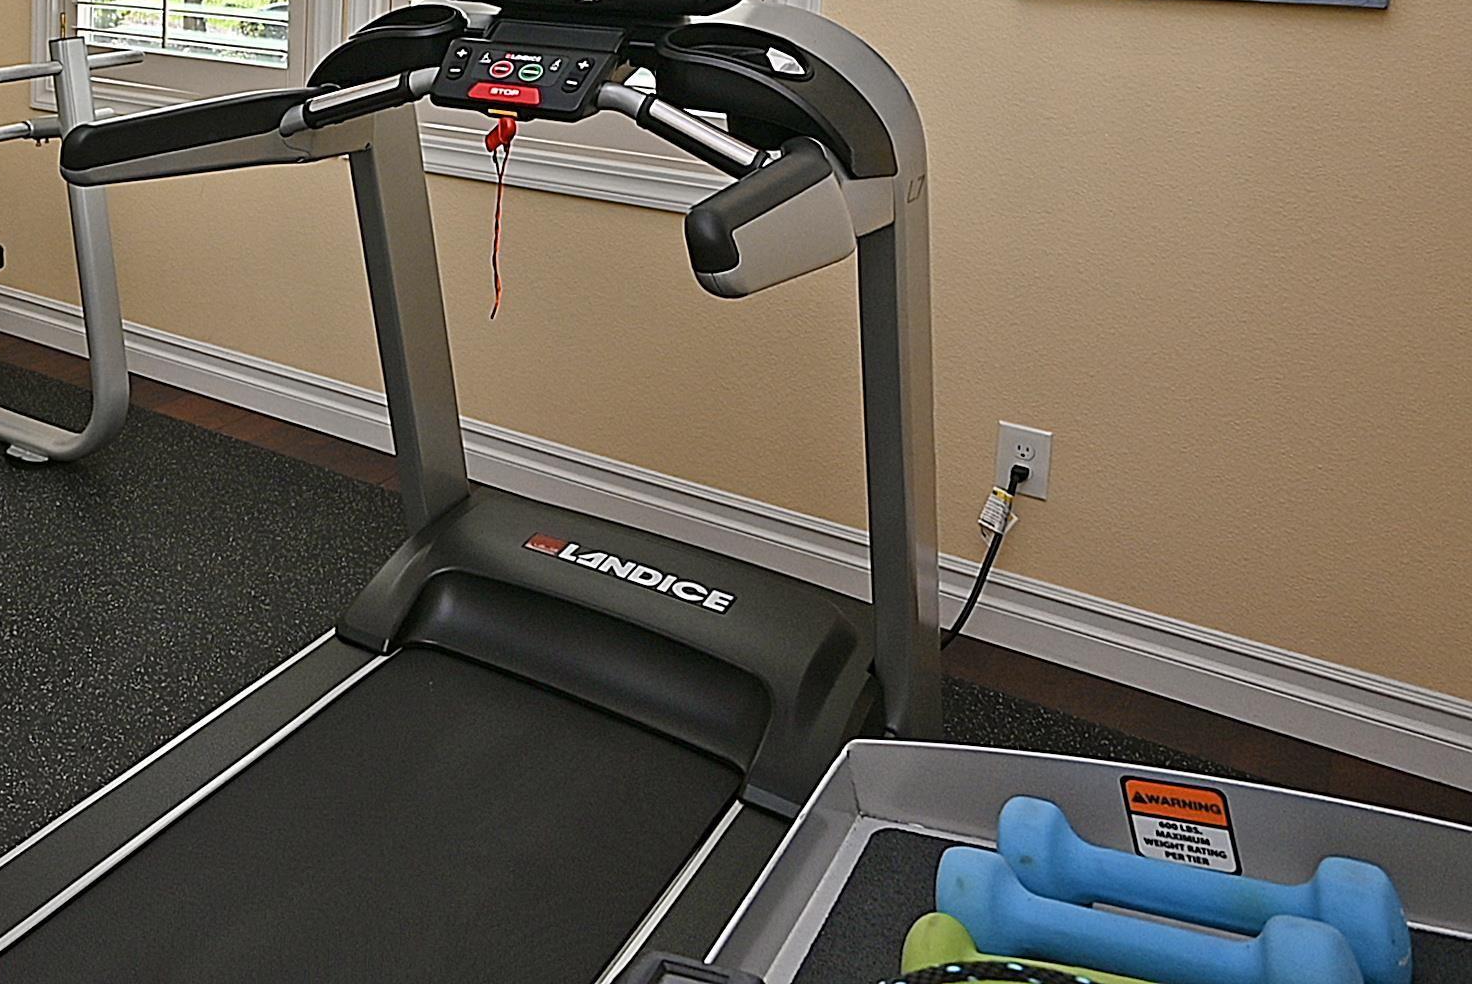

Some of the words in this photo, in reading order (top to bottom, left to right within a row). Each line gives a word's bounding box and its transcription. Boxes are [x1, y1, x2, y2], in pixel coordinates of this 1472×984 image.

[490, 87, 519, 95] STOP
[558, 543, 734, 612] LANDICE
[1147, 794, 1221, 815] WARNING
[1159, 822, 1178, 830] 600
[1180, 825, 1203, 834] LBS.
[1156, 830, 1211, 846] MAXIMUM
[1144, 838, 1185, 851] WEIGHT
[1188, 845, 1228, 859] RATING
[1165, 851, 1185, 861] PER
[1187, 855, 1210, 866] TIER
